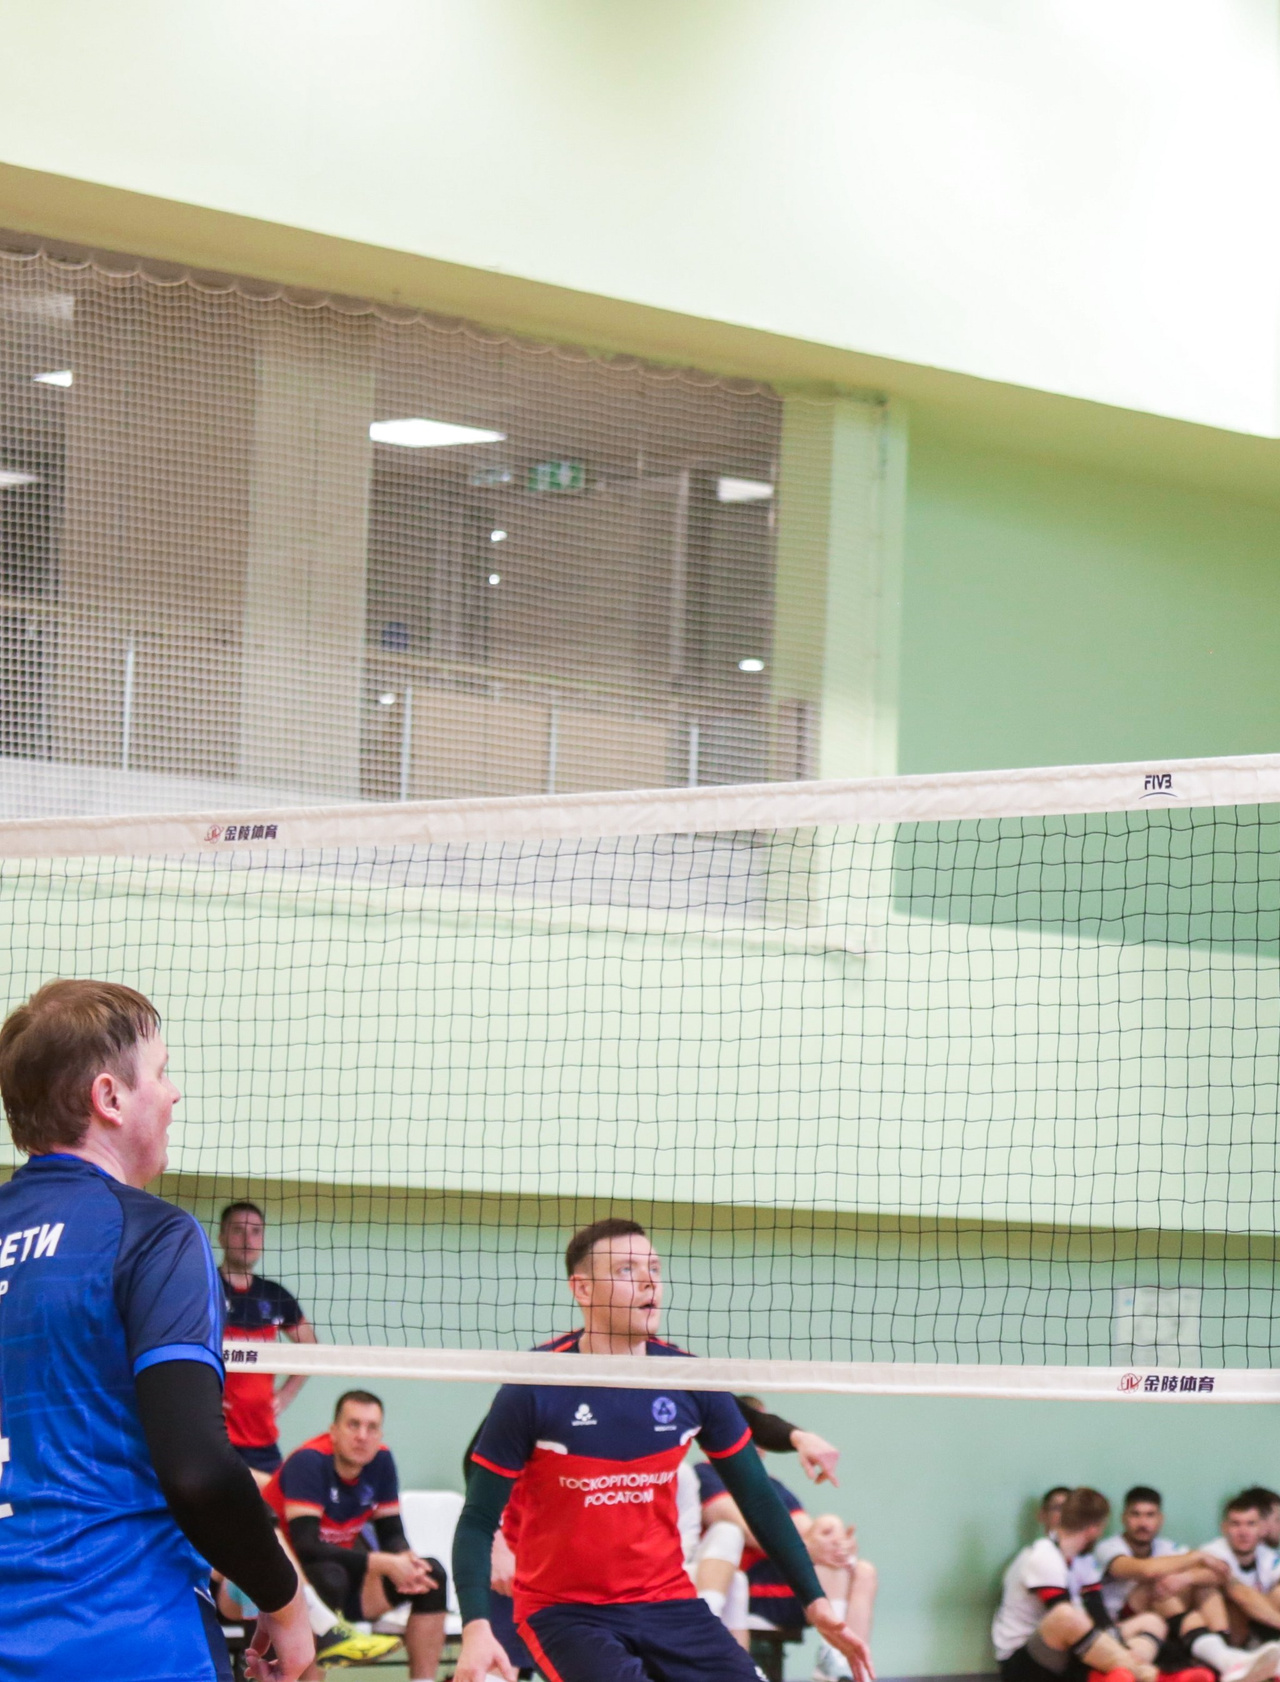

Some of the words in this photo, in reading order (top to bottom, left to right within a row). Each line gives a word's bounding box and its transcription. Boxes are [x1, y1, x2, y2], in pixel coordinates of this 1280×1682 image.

[1144, 773, 1173, 790] FIVB
[224, 823, 278, 841] 金陵体育
[0, 1223, 65, 1269] ЕТИ
[1144, 1375, 1215, 1393] 金陵体育
[584, 1488, 655, 1508] РОСАТОМ
